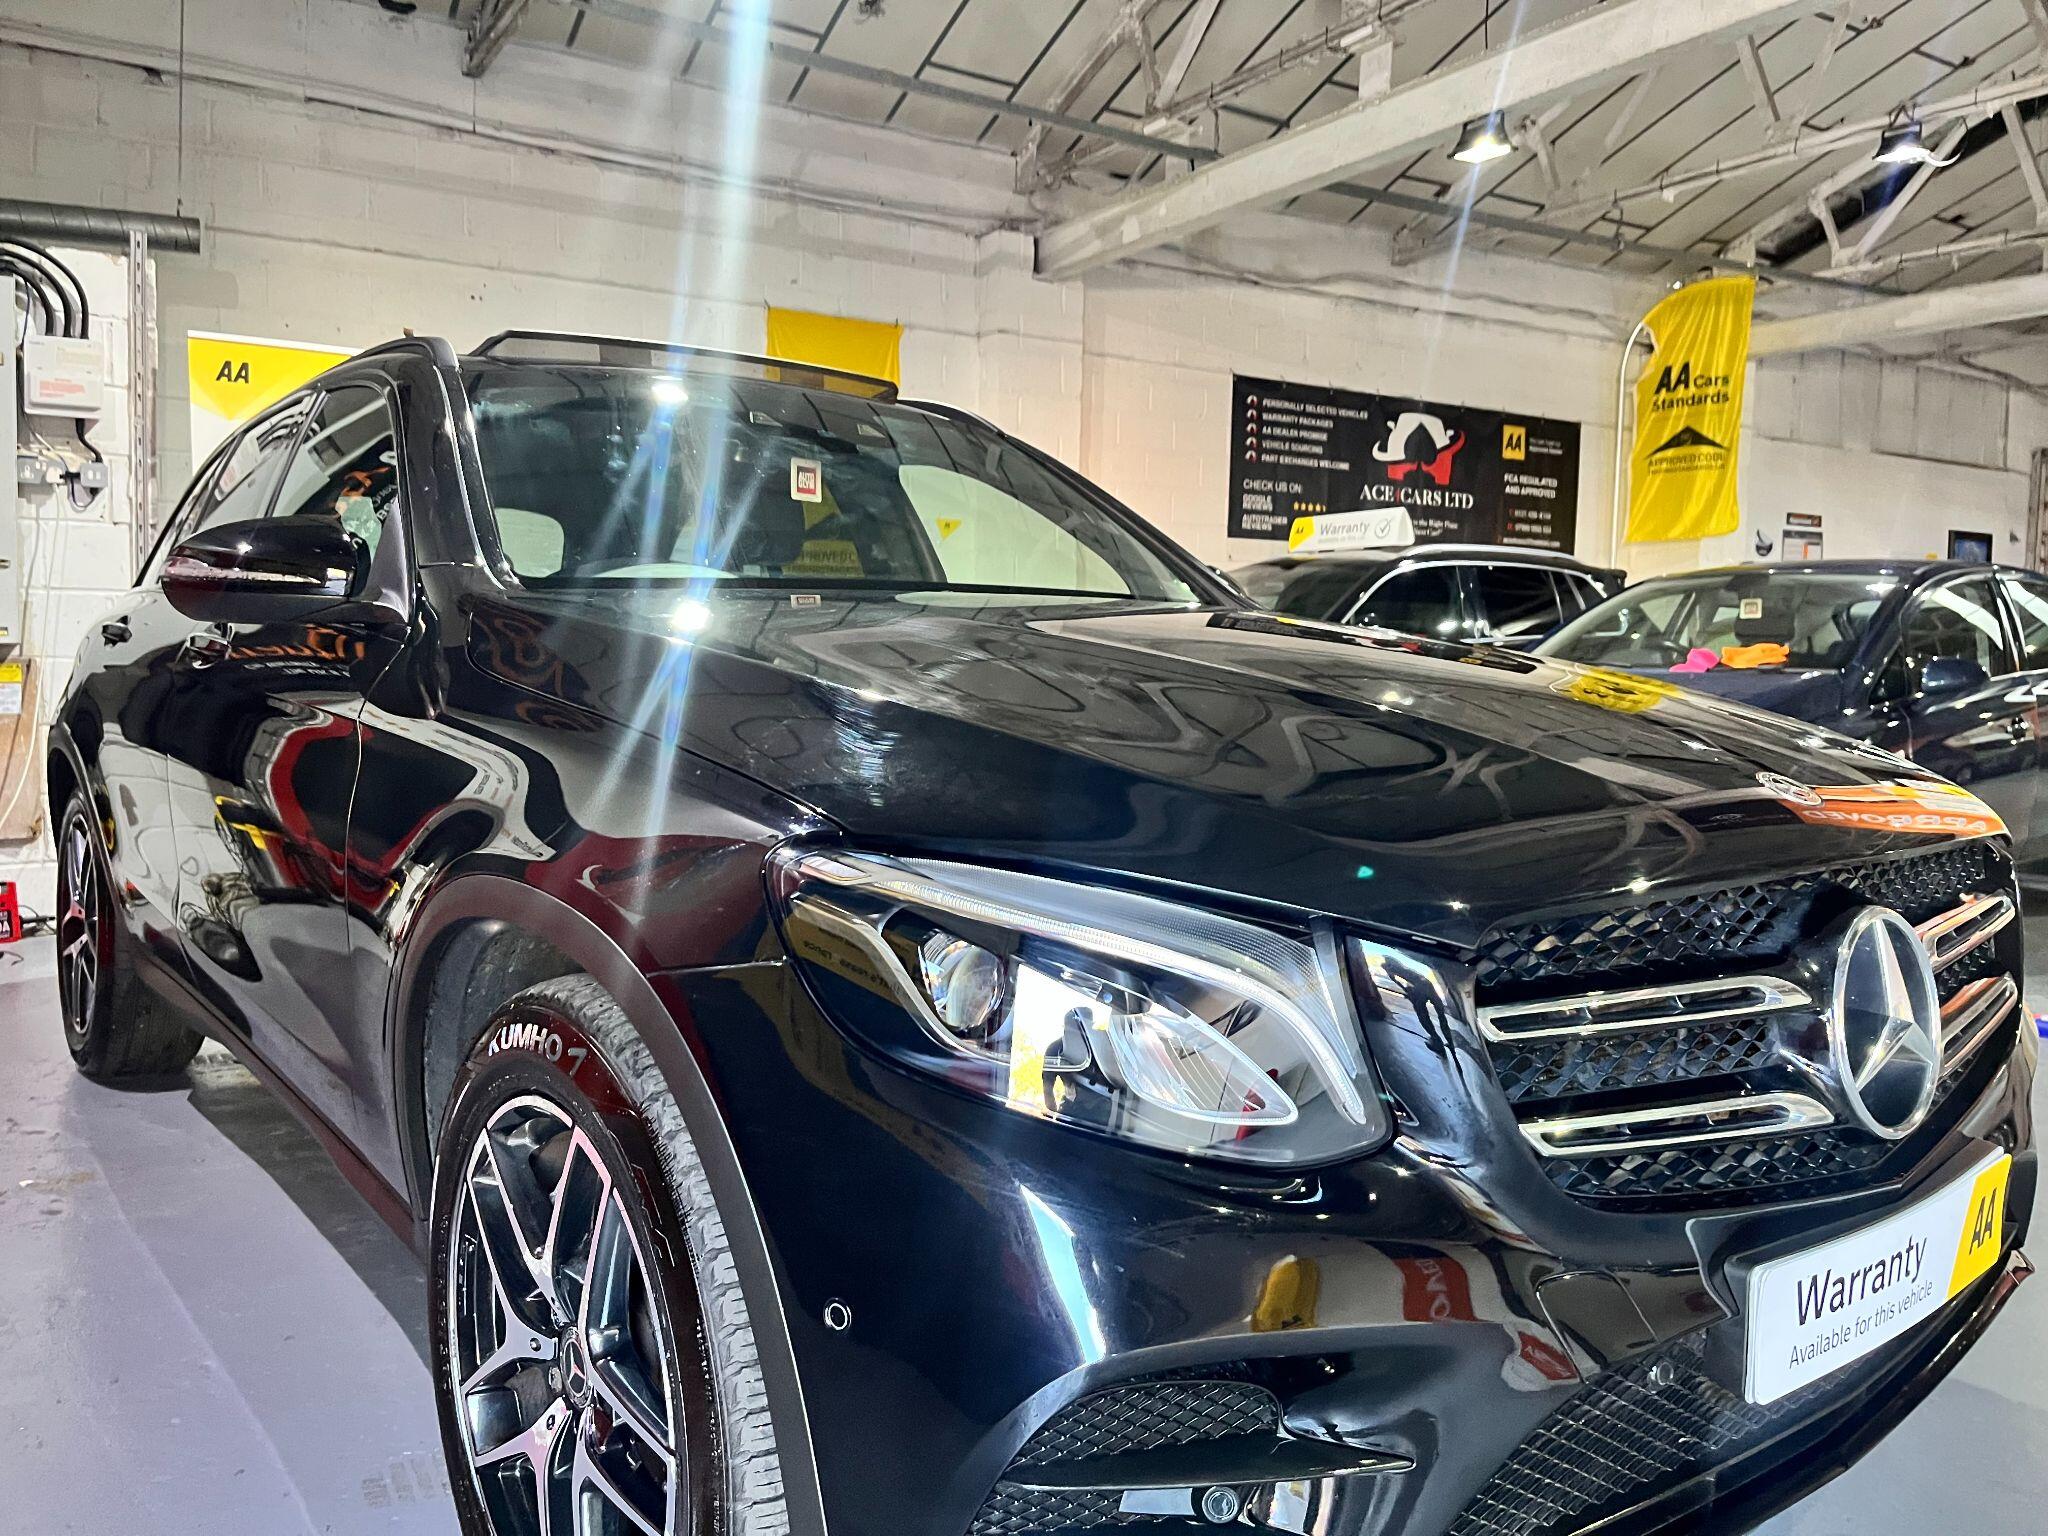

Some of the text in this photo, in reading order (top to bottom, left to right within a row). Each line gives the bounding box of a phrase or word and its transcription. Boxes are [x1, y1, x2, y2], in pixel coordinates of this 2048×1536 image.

[216, 360, 250, 384] AA
[1654, 361, 1730, 395] AA Cars
[1262, 398, 1368, 420] PERSONALLY SELECTED VEHICLES
[1653, 389, 1730, 412] Standards
[1262, 412, 1333, 428] WARRANTY PACKAGES
[1262, 440, 1289, 452] VEHICLE
[1505, 432, 1522, 452] AA
[1261, 453, 1278, 463] PART
[1319, 459, 1350, 471] WELCOME
[1243, 478, 1273, 491] CHECK
[1275, 481, 1288, 492] US
[1504, 473, 1518, 484] FCA
[1360, 484, 1394, 502] ACE
[1401, 487, 1441, 506] CARS
[1445, 491, 1474, 509] LTD
[1505, 485, 1556, 499] AND APPROVED
[1320, 520, 1370, 536] Warranty
[488, 1022, 563, 1062] KUMHO
[1969, 1187, 1998, 1255] AA
[1797, 1234, 1927, 1326] Warranty
[1789, 1279, 1933, 1369] Available for this vehicle
